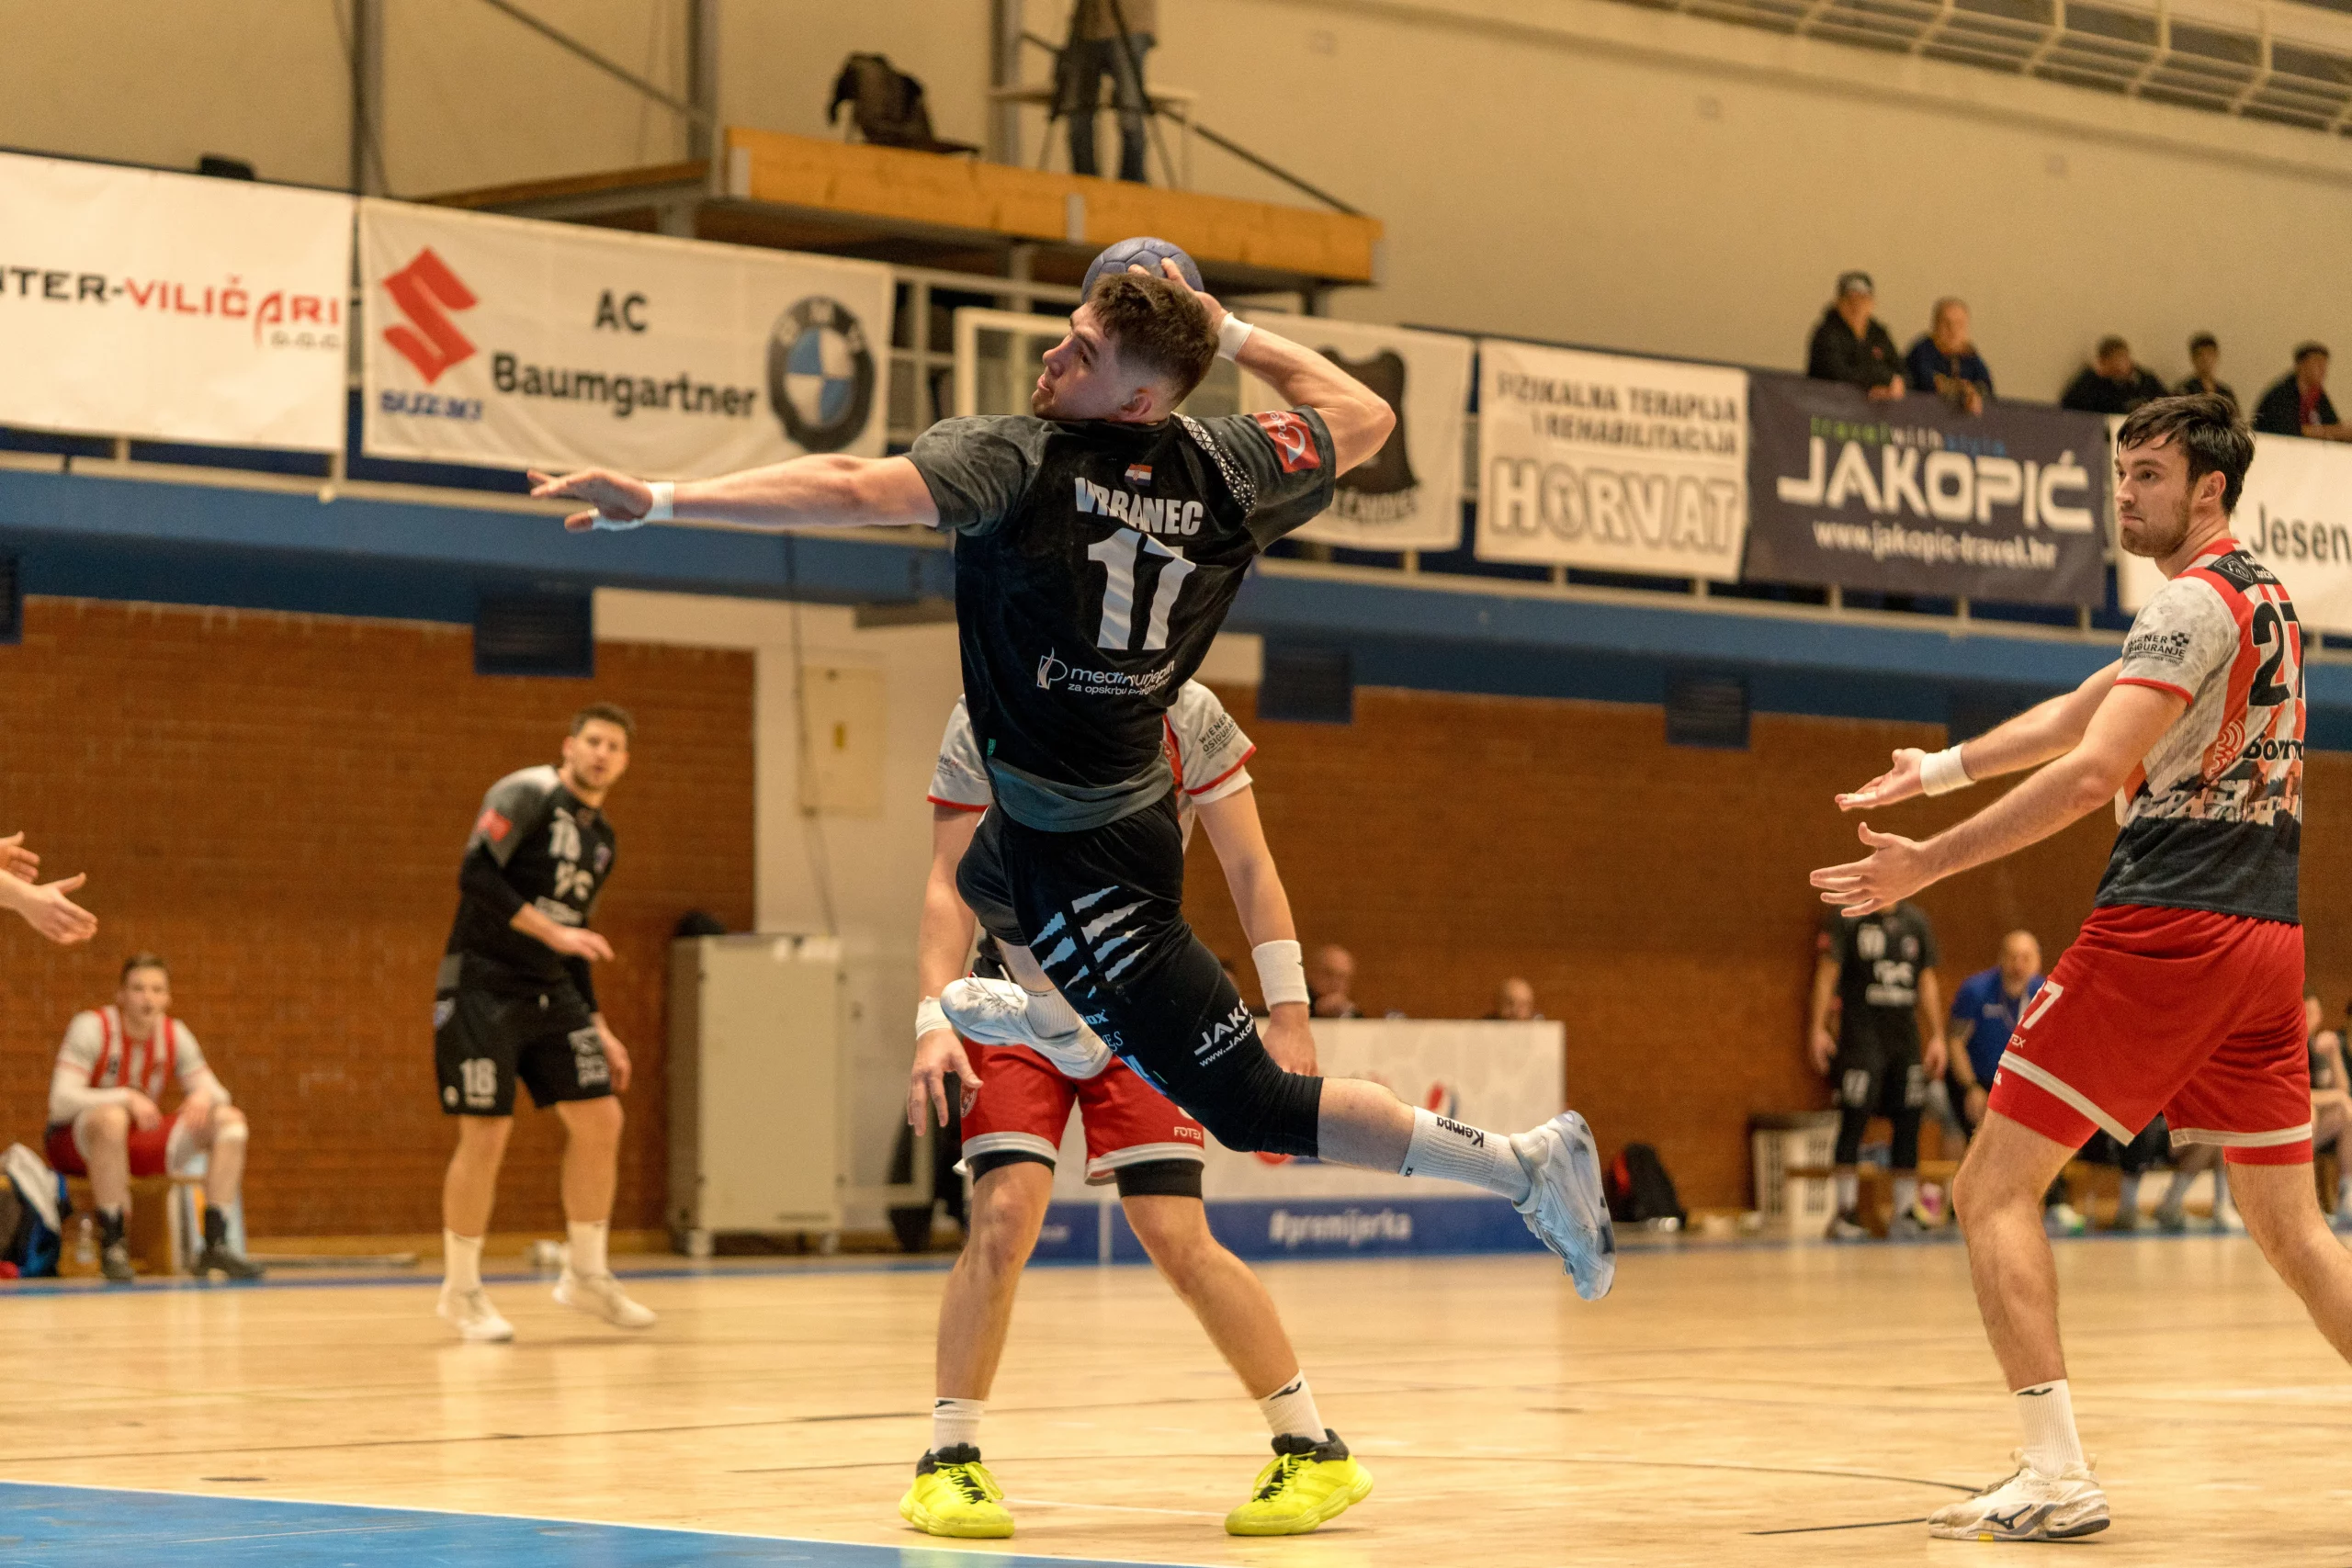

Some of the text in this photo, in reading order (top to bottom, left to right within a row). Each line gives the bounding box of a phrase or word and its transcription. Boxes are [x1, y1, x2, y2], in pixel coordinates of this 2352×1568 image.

[594, 290, 649, 333] AC
[492, 353, 759, 418] Baumgartner
[1489, 456, 1739, 554] HORVAT
[1778, 434, 2095, 534] JAKOPIĆ
[2249, 502, 2352, 565] Jesen
[1088, 527, 1196, 650] 17
[2129, 643, 2186, 658] IGURANJE
[1068, 682, 1081, 692] za
[1199, 713, 1227, 744] WIENER
[1174, 1126, 1201, 1140] FOTEX
[1436, 1116, 1484, 1148] Kempa
